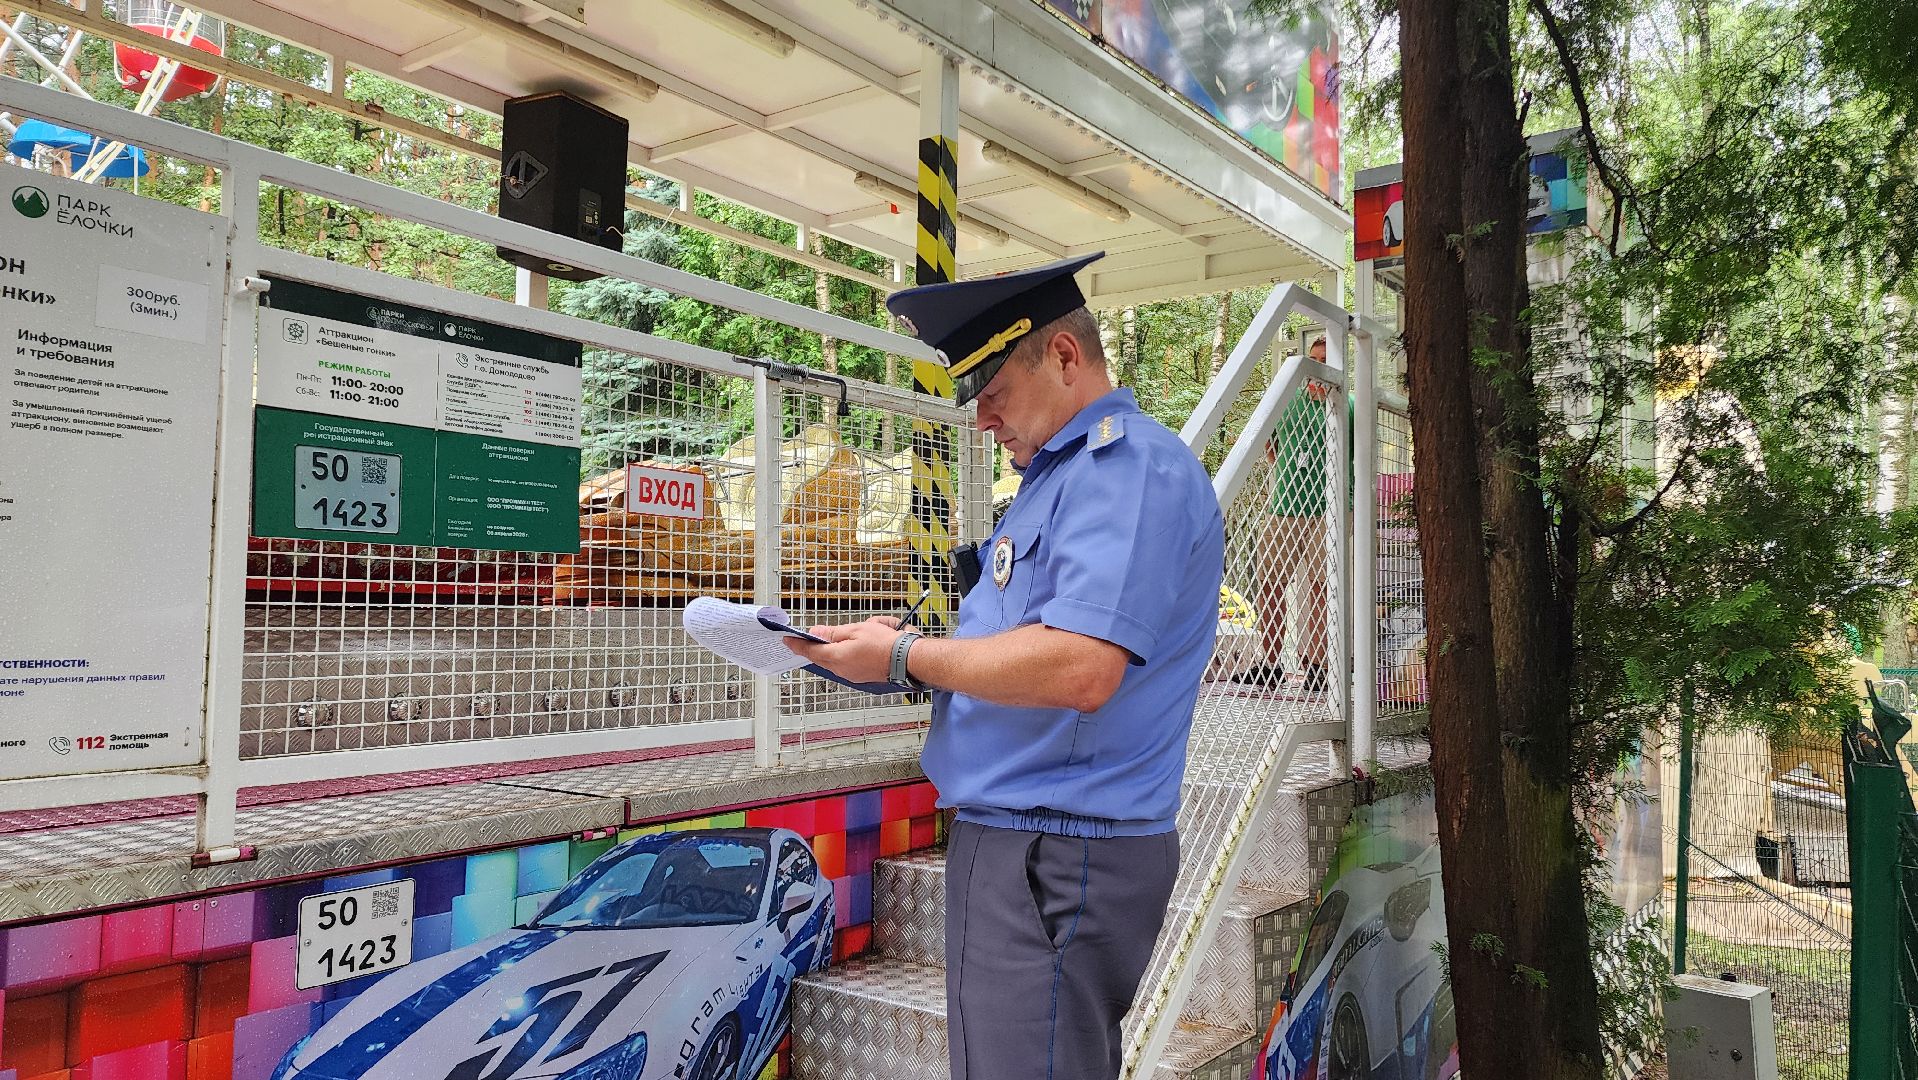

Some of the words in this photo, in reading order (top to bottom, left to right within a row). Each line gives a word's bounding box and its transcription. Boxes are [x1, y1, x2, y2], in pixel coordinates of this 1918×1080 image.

[57, 194, 111, 218] ПАРК
[57, 210, 134, 238] ЁЛОЧКИ
[0, 285, 56, 304] НКИ»
[126, 286, 180, 306] 300руб.
[130, 302, 178, 319] (3мин.)
[319, 326, 374, 344] Аттракцион
[458, 326, 476, 334] ПАРК
[18, 328, 113, 353] Информация
[316, 338, 364, 352] «Бешеные
[366, 347, 396, 357] гонки»
[16, 346, 26, 356] и
[30, 348, 115, 368] требования
[474, 354, 522, 369] Экстренные
[318, 360, 353, 372] РЕЖИМ
[355, 366, 391, 378] РАБОТЫ
[14, 368, 26, 376] За
[28, 372, 76, 383] поведение
[77, 378, 102, 387] детей
[116, 383, 169, 396] аттракционе
[14, 380, 57, 391] отвечают
[58, 386, 100, 396] родители
[370, 382, 404, 396] 20:00
[368, 395, 399, 408] 21:00
[11, 420, 41, 430] ущерб
[314, 422, 385, 437] Государственный
[304, 432, 375, 444] регистрационный
[312, 452, 348, 482] 50
[639, 477, 696, 512] ВХОД
[312, 497, 388, 528] 1423
[22, 676, 84, 686] нарушения
[86, 674, 126, 684] данных
[129, 674, 165, 682] правил
[76, 736, 105, 750] 112
[110, 732, 169, 742] Экстренная
[109, 742, 150, 752] помощь
[318, 896, 358, 930] 50
[318, 934, 396, 977] 1423
